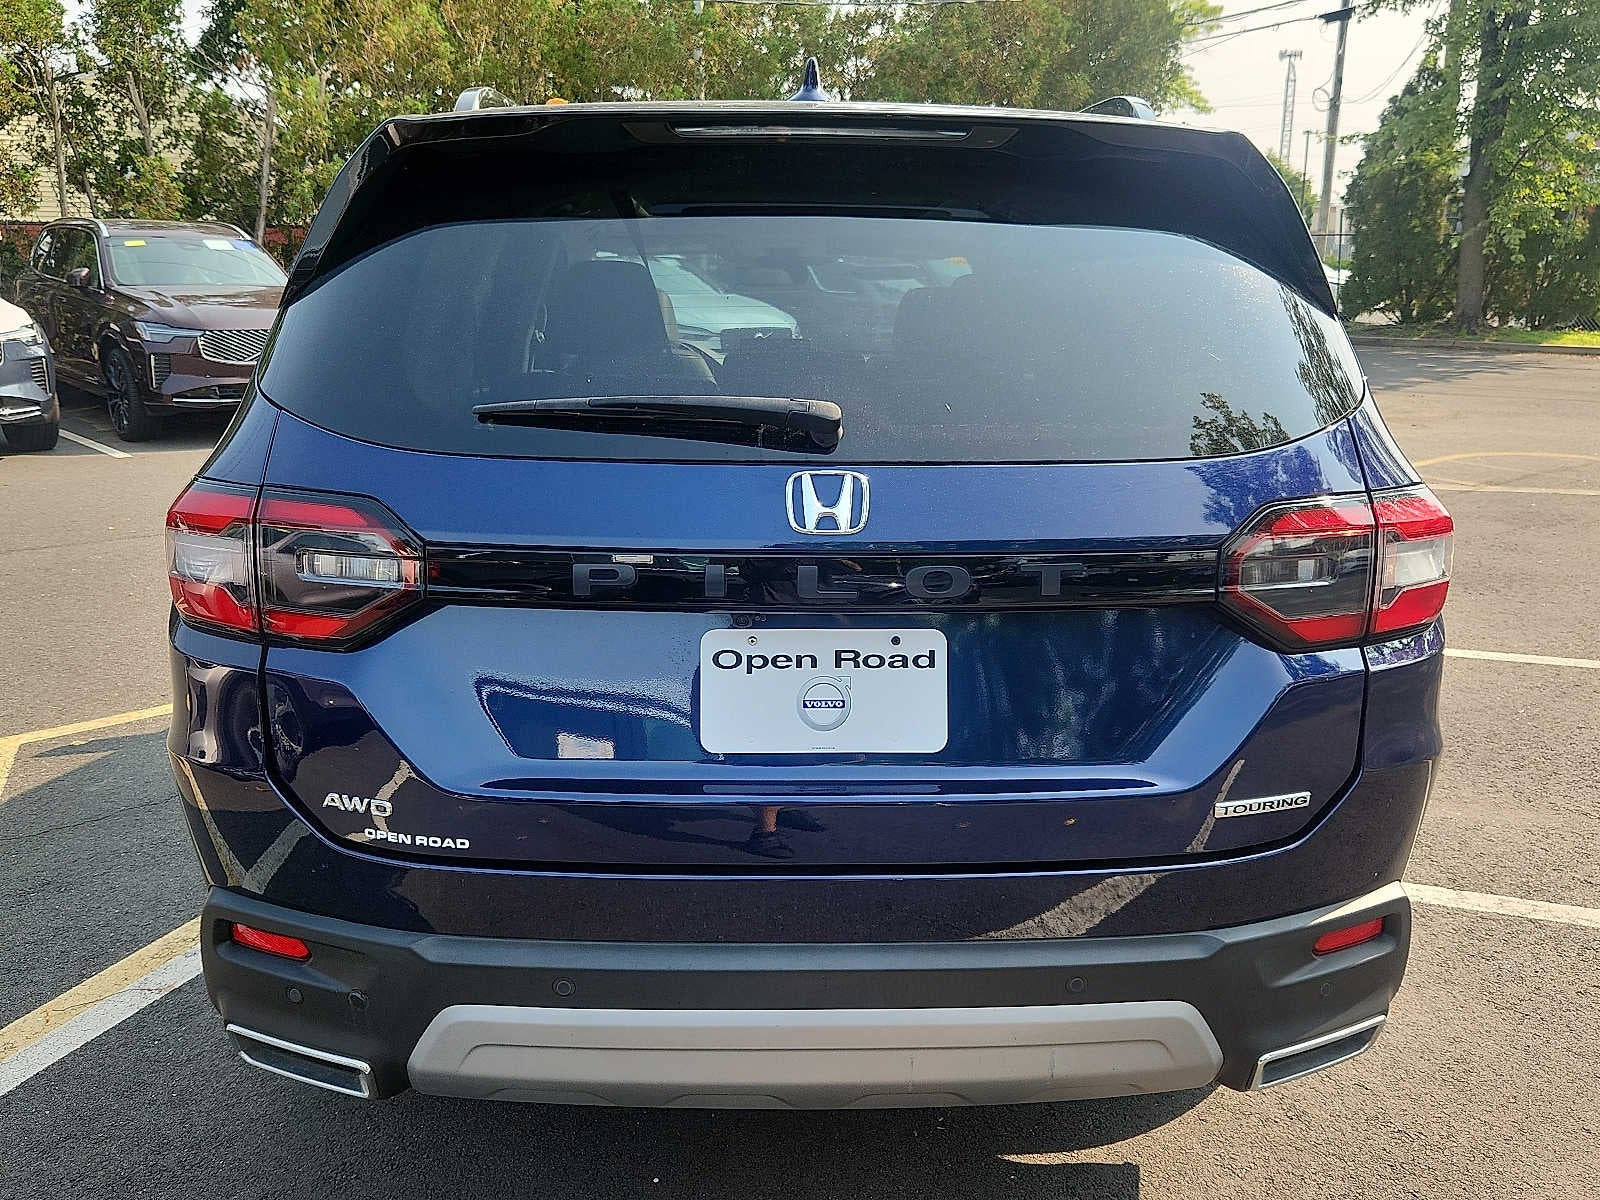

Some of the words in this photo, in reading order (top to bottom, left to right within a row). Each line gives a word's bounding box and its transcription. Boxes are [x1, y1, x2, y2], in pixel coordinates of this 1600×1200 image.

[572, 563, 1084, 598] PILOT
[711, 649, 818, 674] Open
[834, 649, 936, 669] Road
[805, 700, 844, 708] VOLVO
[322, 792, 393, 817] AWD
[1220, 796, 1308, 815] TOURING
[364, 828, 412, 845] OPEN
[415, 835, 470, 849] ROAD
